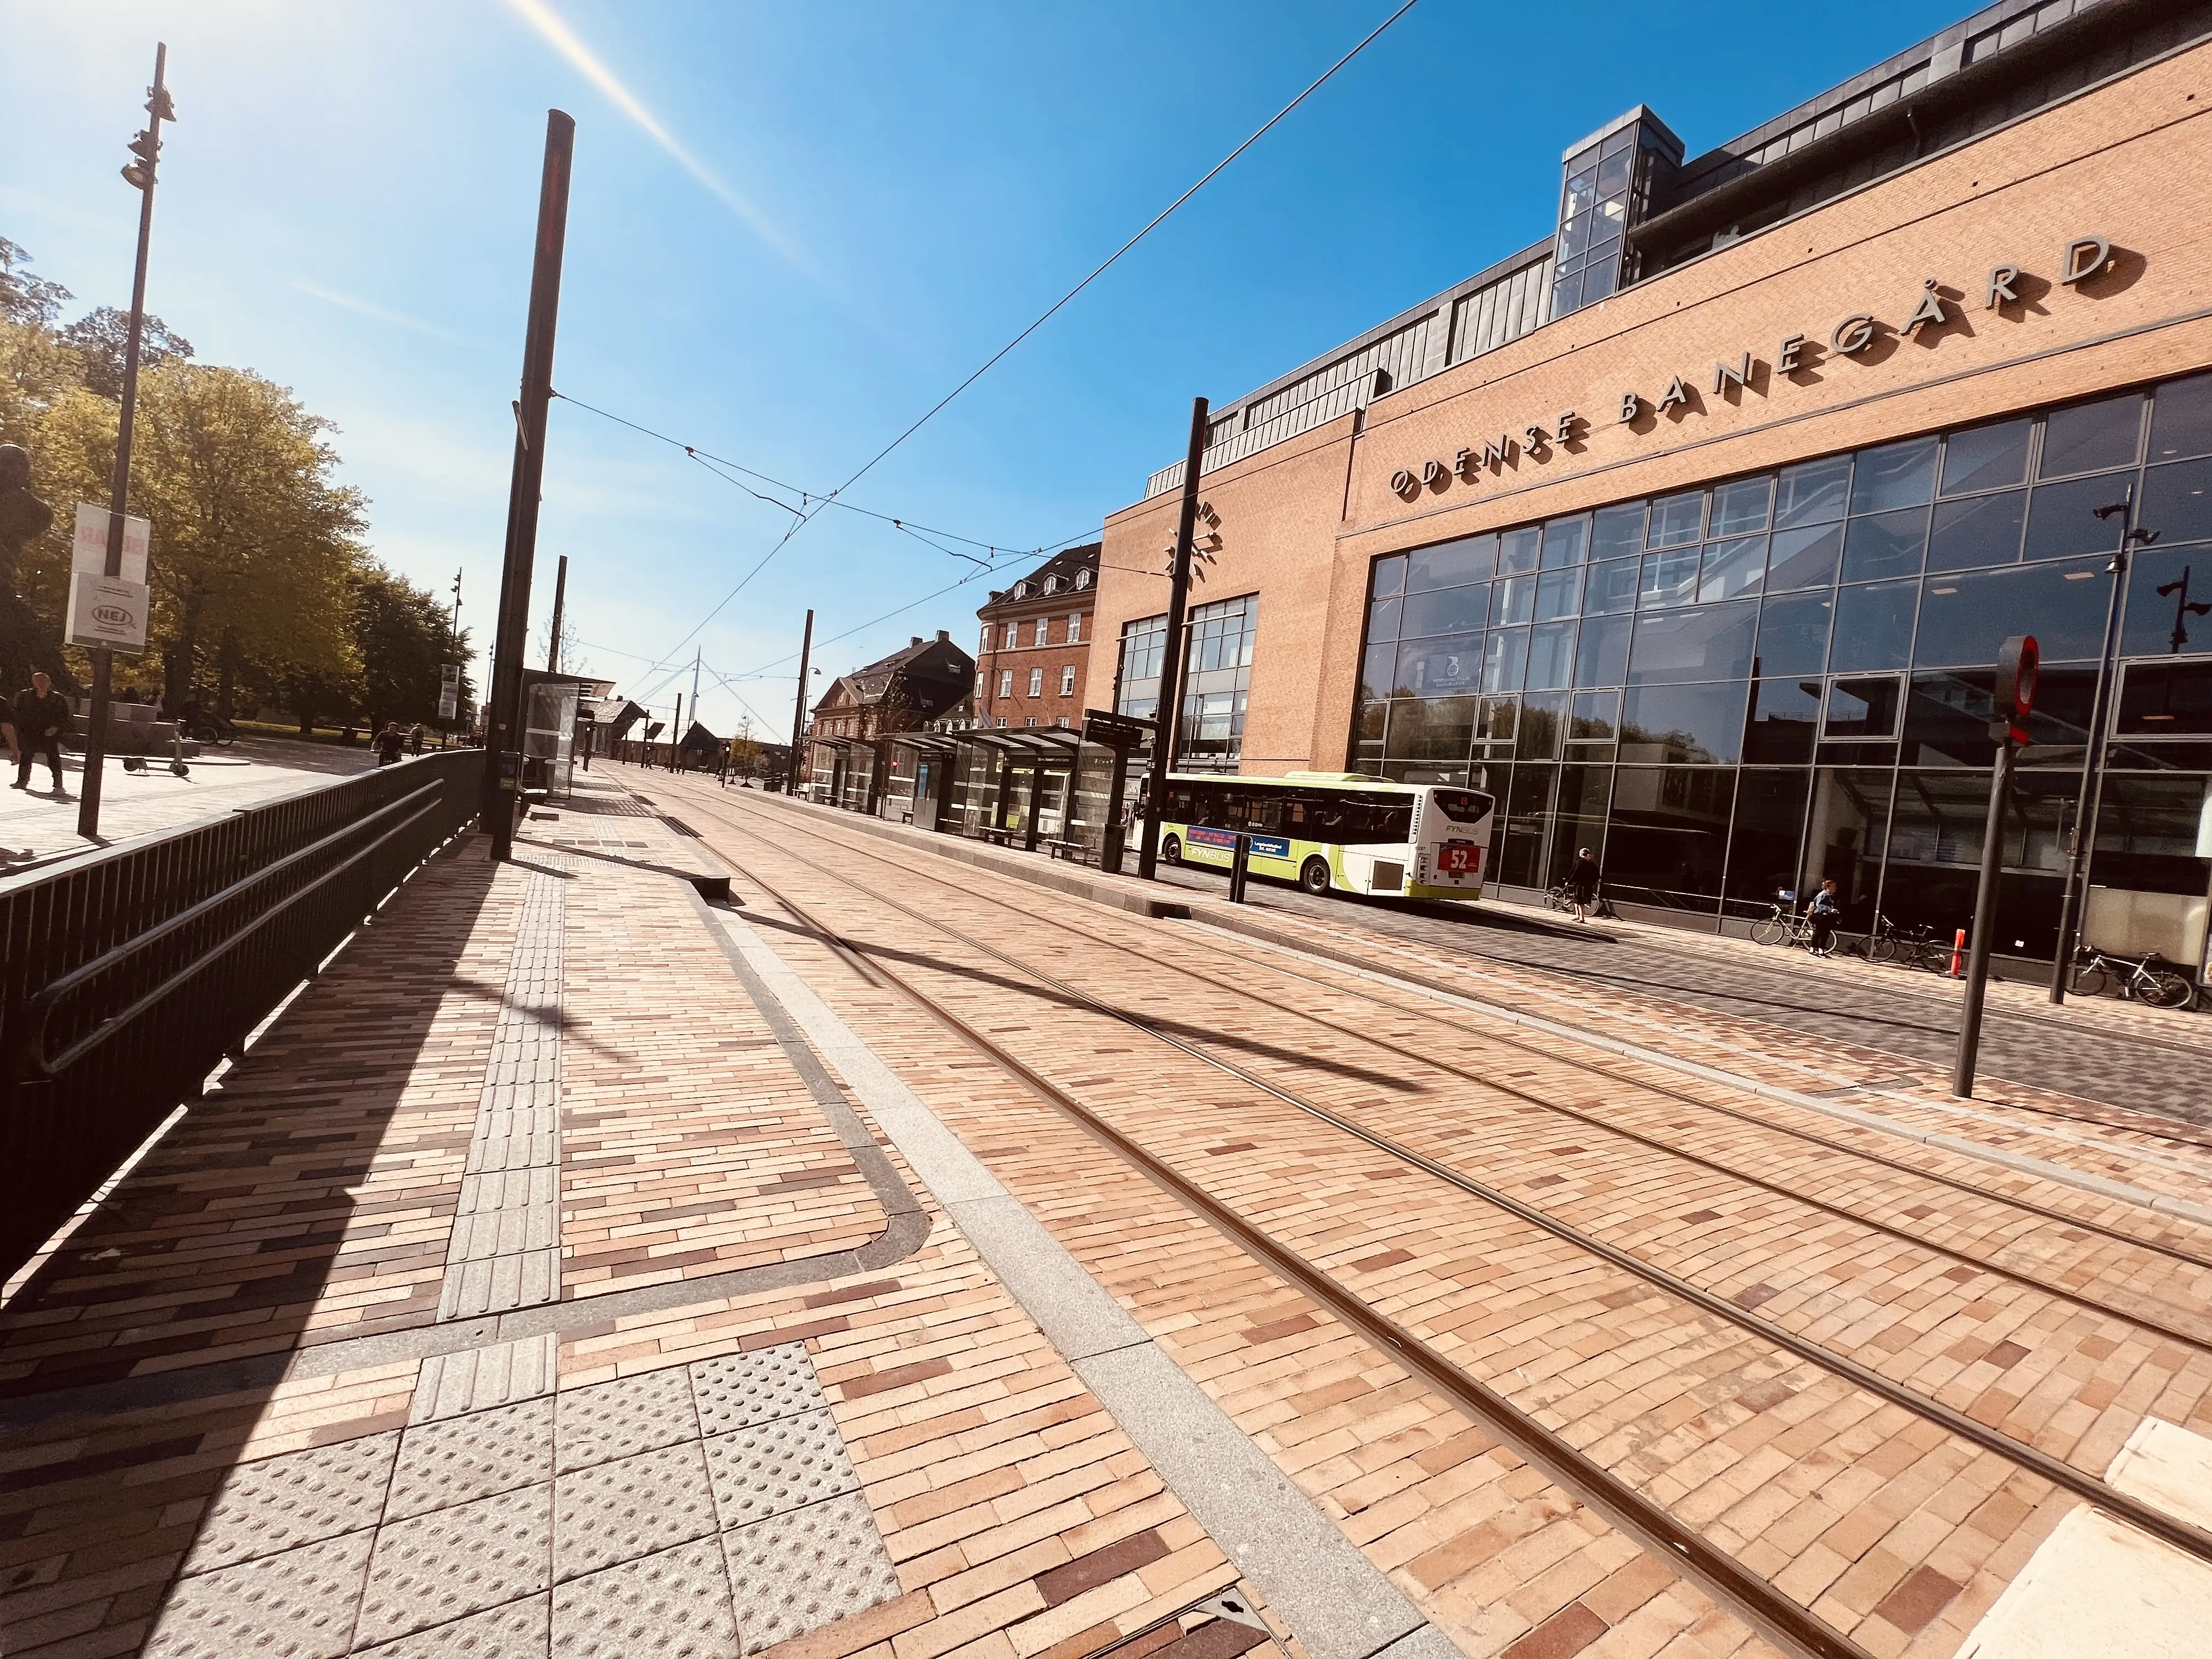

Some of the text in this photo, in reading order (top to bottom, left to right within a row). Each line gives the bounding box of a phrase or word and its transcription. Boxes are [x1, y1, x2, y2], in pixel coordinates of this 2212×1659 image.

[1390, 234, 2111, 494] ODENSE BANEGÅRD
[98, 609, 126, 622] NEJ
[1446, 825, 1479, 834] FYNBUS
[1191, 848, 1231, 862] FYNBUS
[1451, 850, 1468, 869] 52
